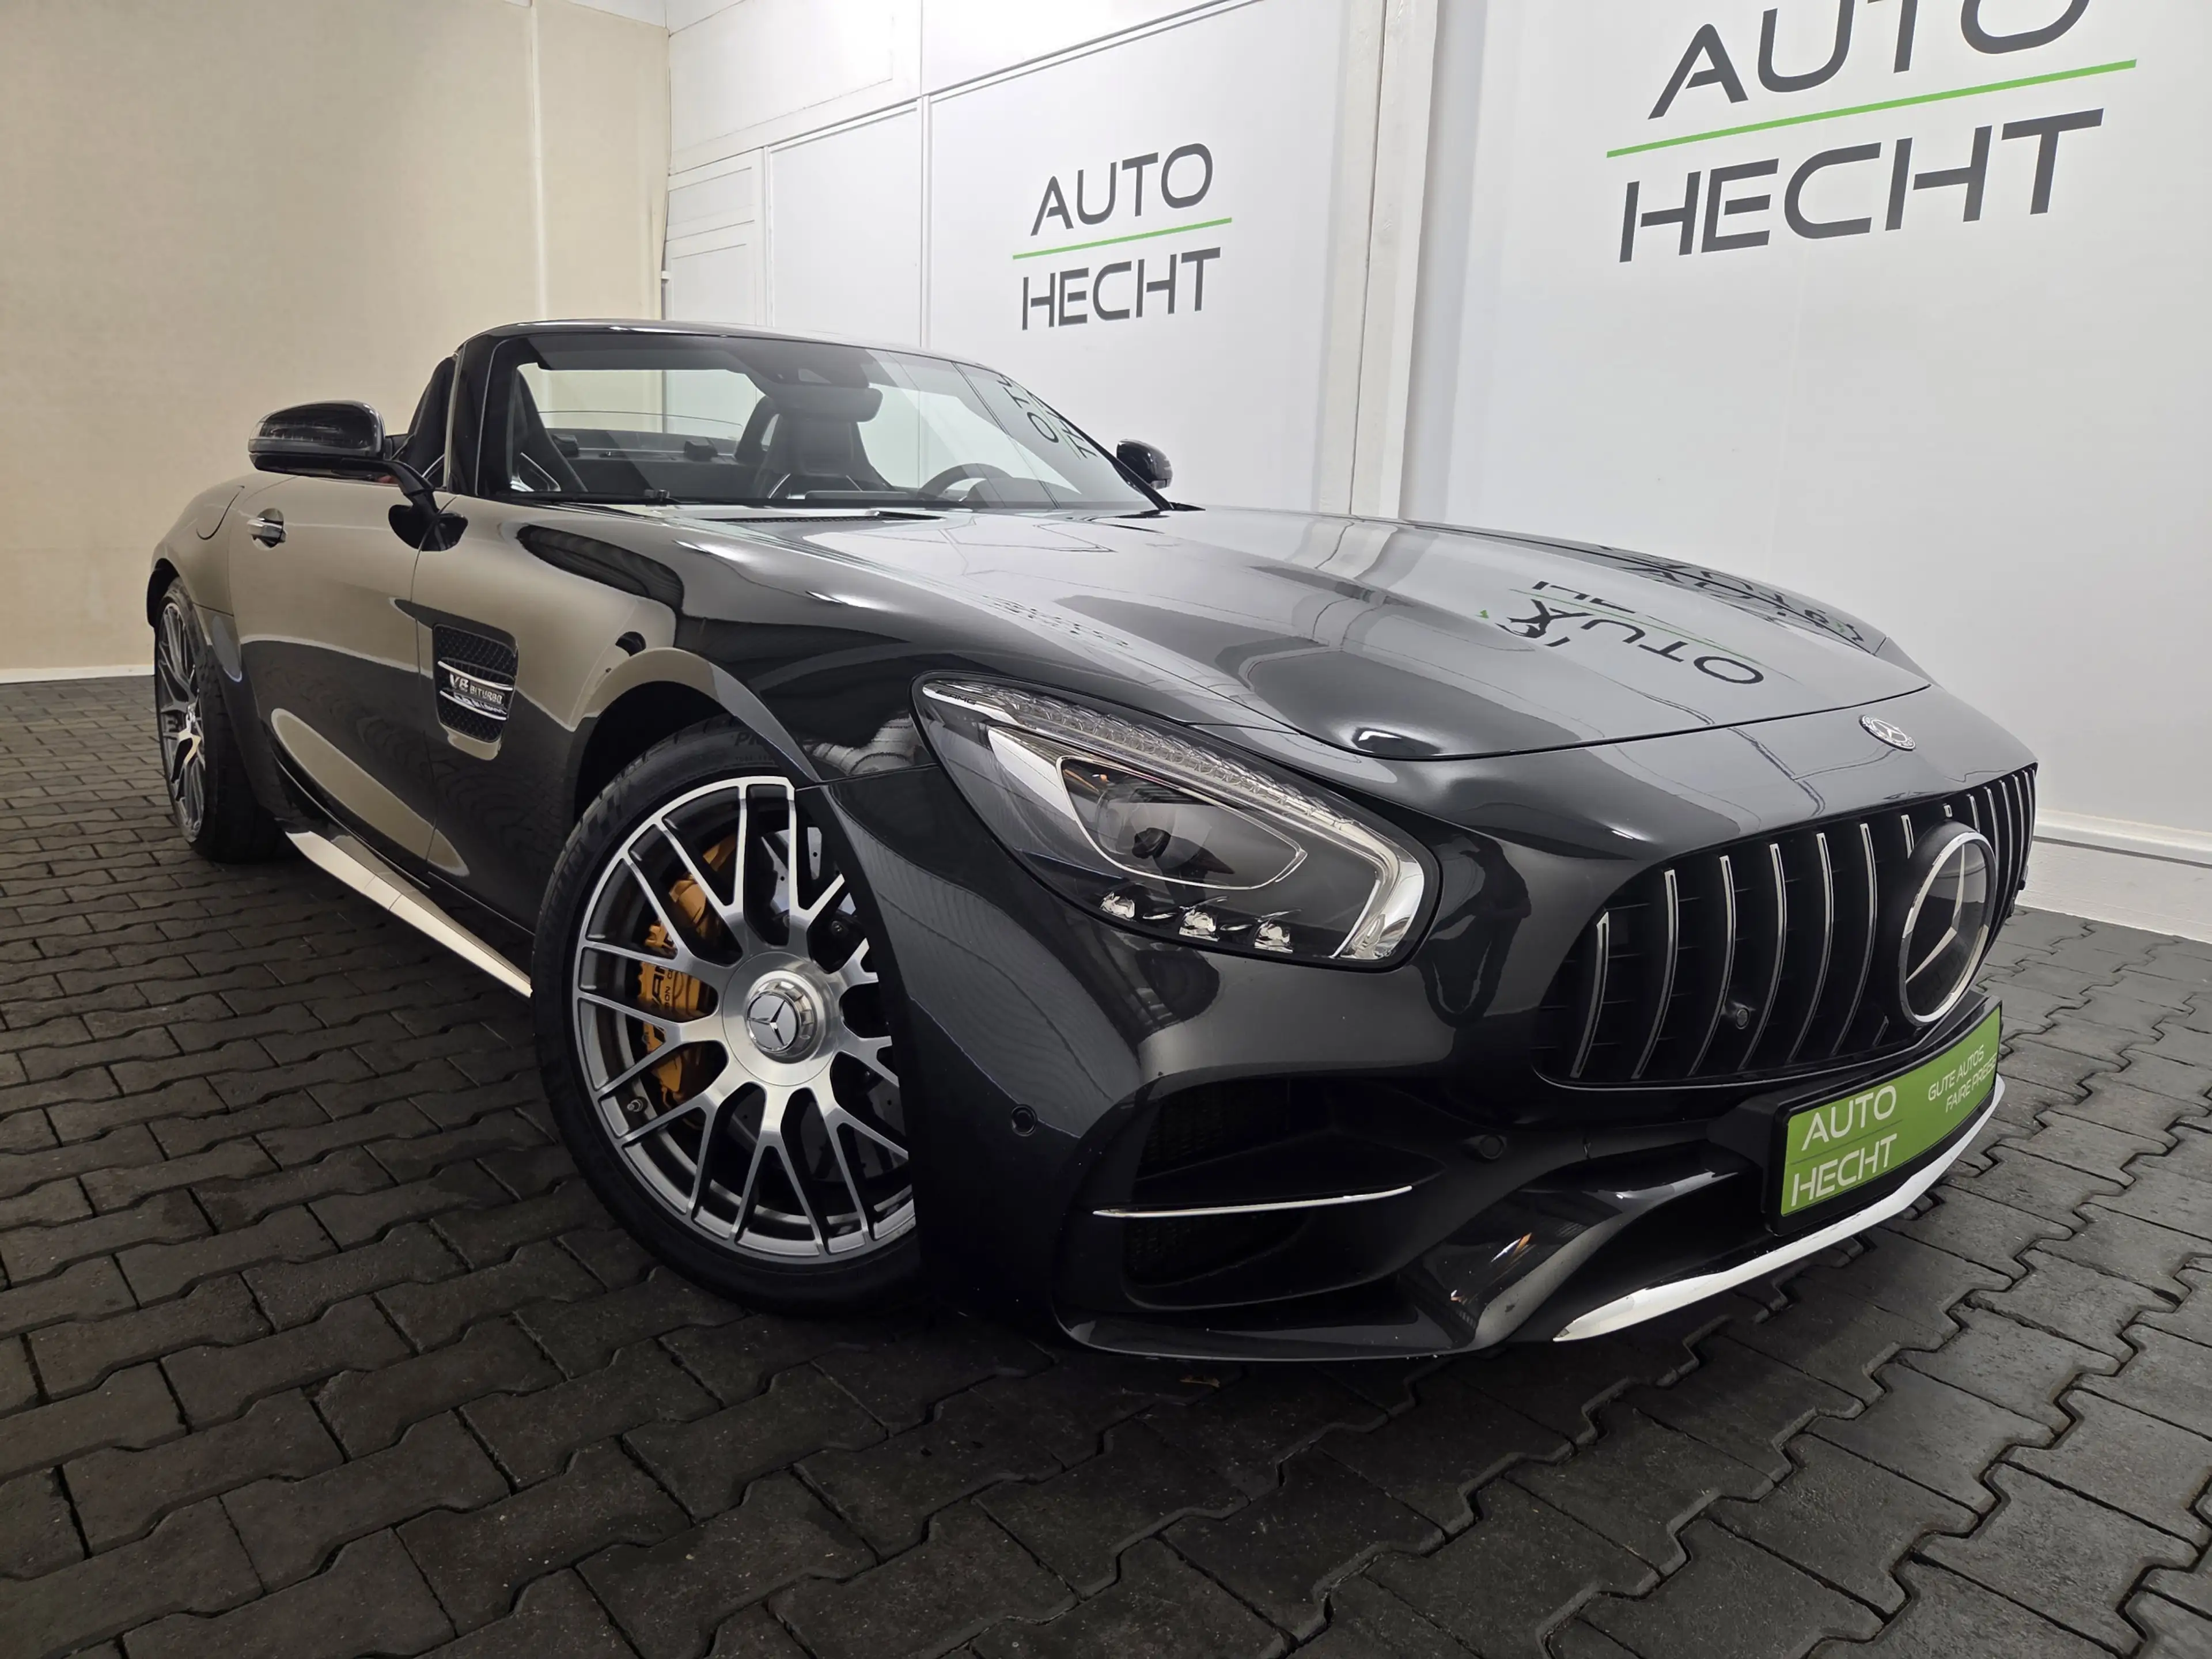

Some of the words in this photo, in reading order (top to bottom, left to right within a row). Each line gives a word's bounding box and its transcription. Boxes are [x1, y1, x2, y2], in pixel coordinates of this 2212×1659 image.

[1030, 143, 1213, 236] AUTO
[1619, 108, 2104, 263] HECHT
[1022, 247, 1221, 331] HECHT
[449, 672, 469, 692] V8
[469, 684, 503, 704] BITURBO
[1927, 1069, 1956, 1101] GUTE
[1956, 1044, 1984, 1082] AUTOS
[1945, 1079, 1971, 1113] FAIRE
[1801, 1085, 1897, 1151] AUTO
[1790, 1133, 1897, 1207] HECHT
